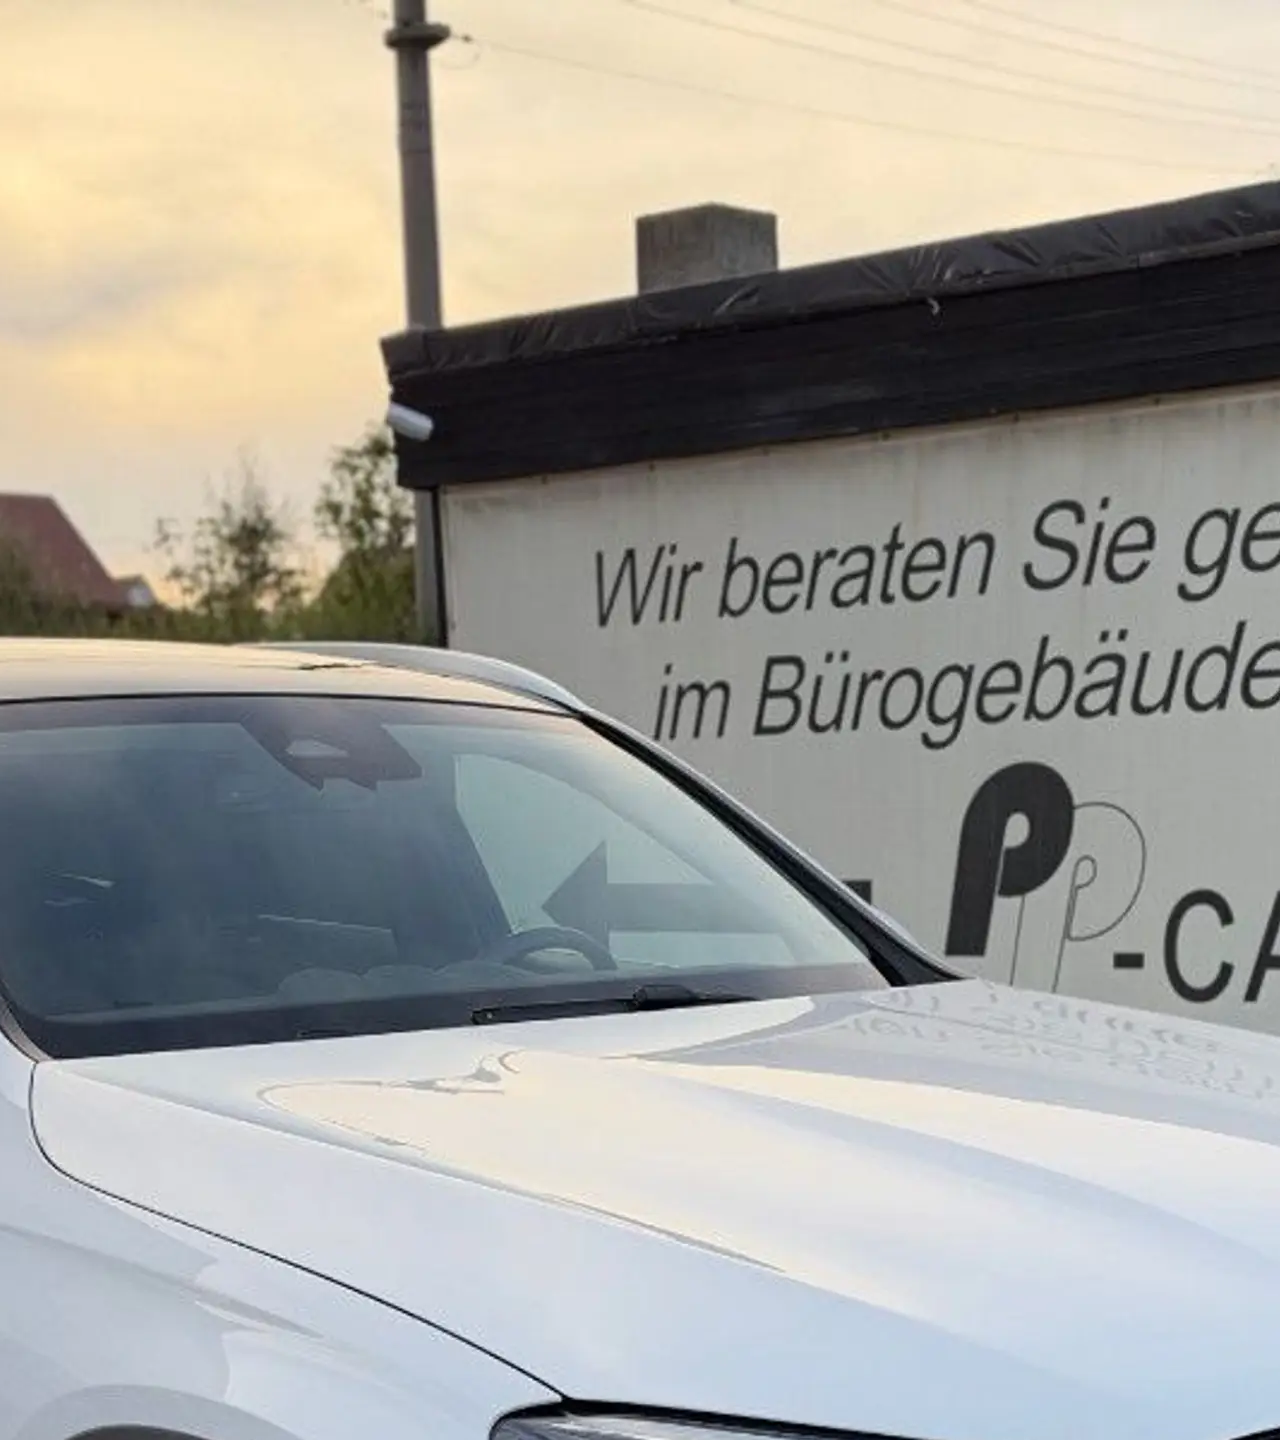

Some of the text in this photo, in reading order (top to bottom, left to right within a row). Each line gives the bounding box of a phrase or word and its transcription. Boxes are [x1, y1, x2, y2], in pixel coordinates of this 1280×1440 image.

[595, 543, 703, 628] Wir
[718, 522, 996, 618] beraten
[1023, 496, 1156, 590] Sie
[653, 663, 731, 741] im
